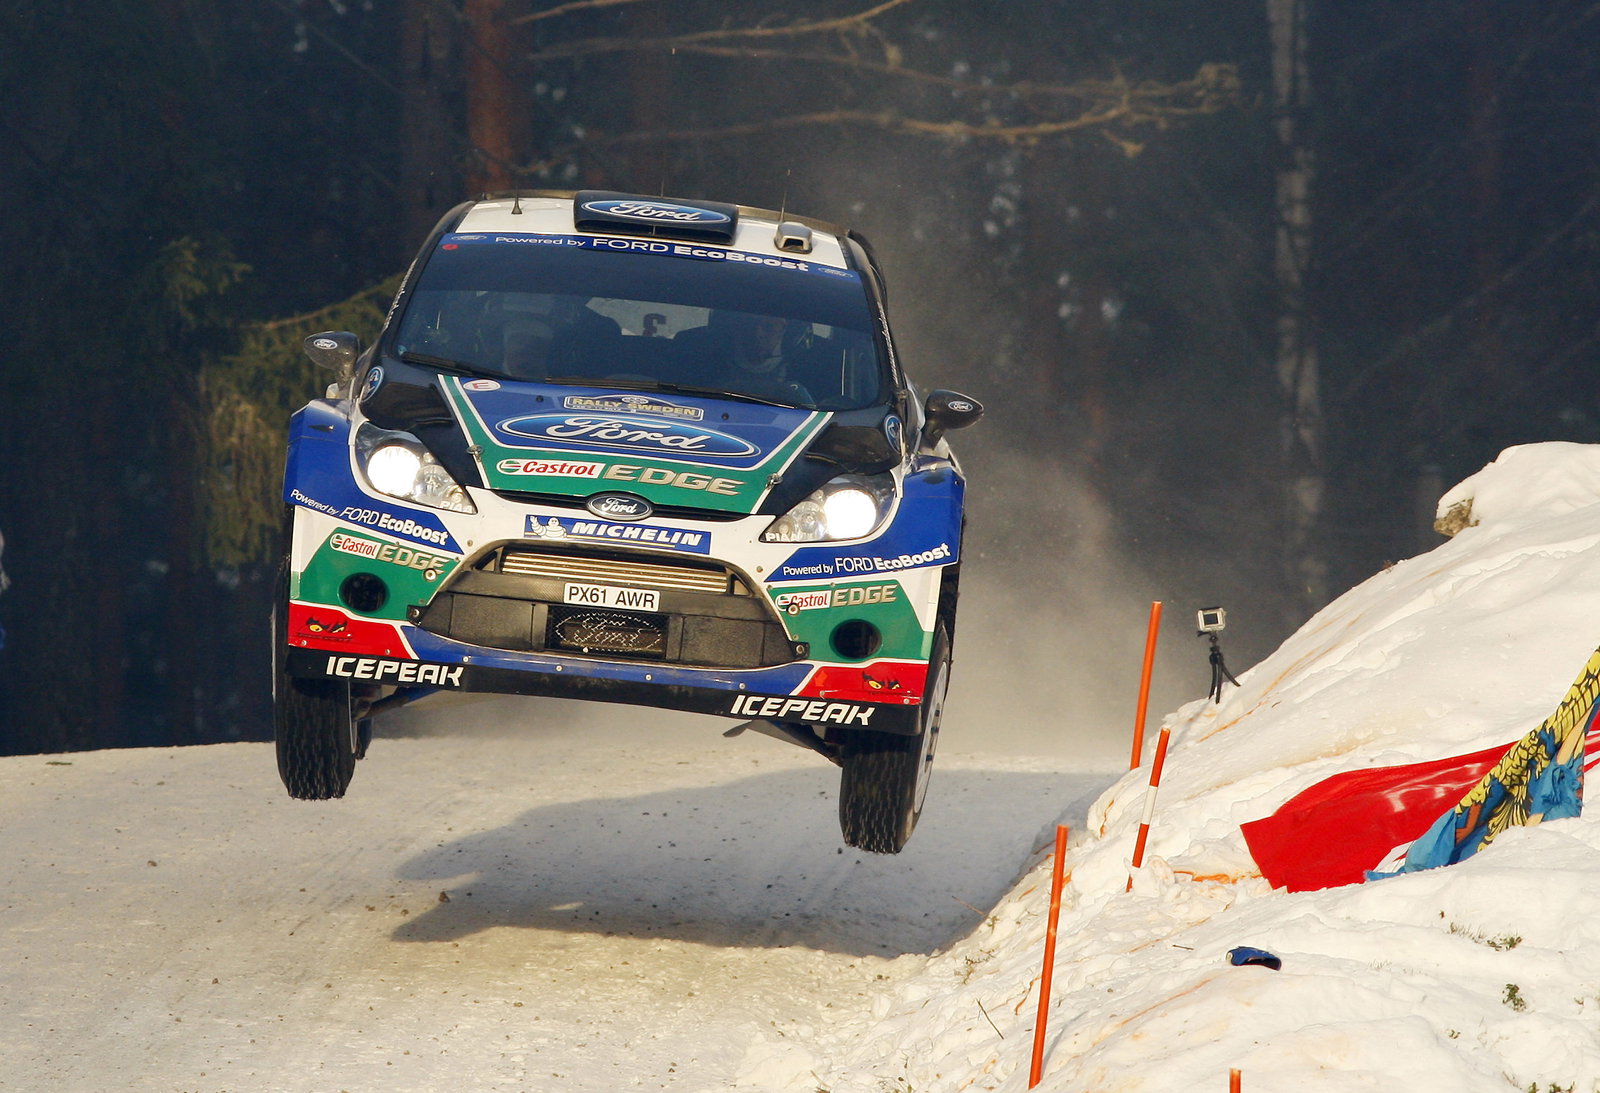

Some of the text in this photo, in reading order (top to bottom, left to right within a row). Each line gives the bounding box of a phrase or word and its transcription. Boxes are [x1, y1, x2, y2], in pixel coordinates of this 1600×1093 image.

[609, 202, 701, 220] Ford
[495, 236, 562, 246] Powered
[567, 240, 586, 248] by
[592, 238, 669, 253] FORD
[673, 245, 809, 272] EcoBoost
[572, 398, 623, 408] RALLY
[626, 403, 696, 416] SWEDEN
[546, 416, 711, 450] Ford
[522, 461, 748, 496] Castrol EDGE
[290, 488, 450, 546] Powered by FORD EcoBoost
[440, 501, 473, 514] PIAA
[600, 497, 638, 514] Ford
[571, 521, 703, 547] MICHELIN
[341, 537, 450, 575] Castrol EDGE
[782, 542, 951, 576] Powered by FORD EcoBoost
[568, 586, 656, 609] PX61 AWR
[831, 584, 899, 608] EDGE
[326, 656, 464, 687] ICEPEAK
[730, 694, 876, 726] ICEPEAK
